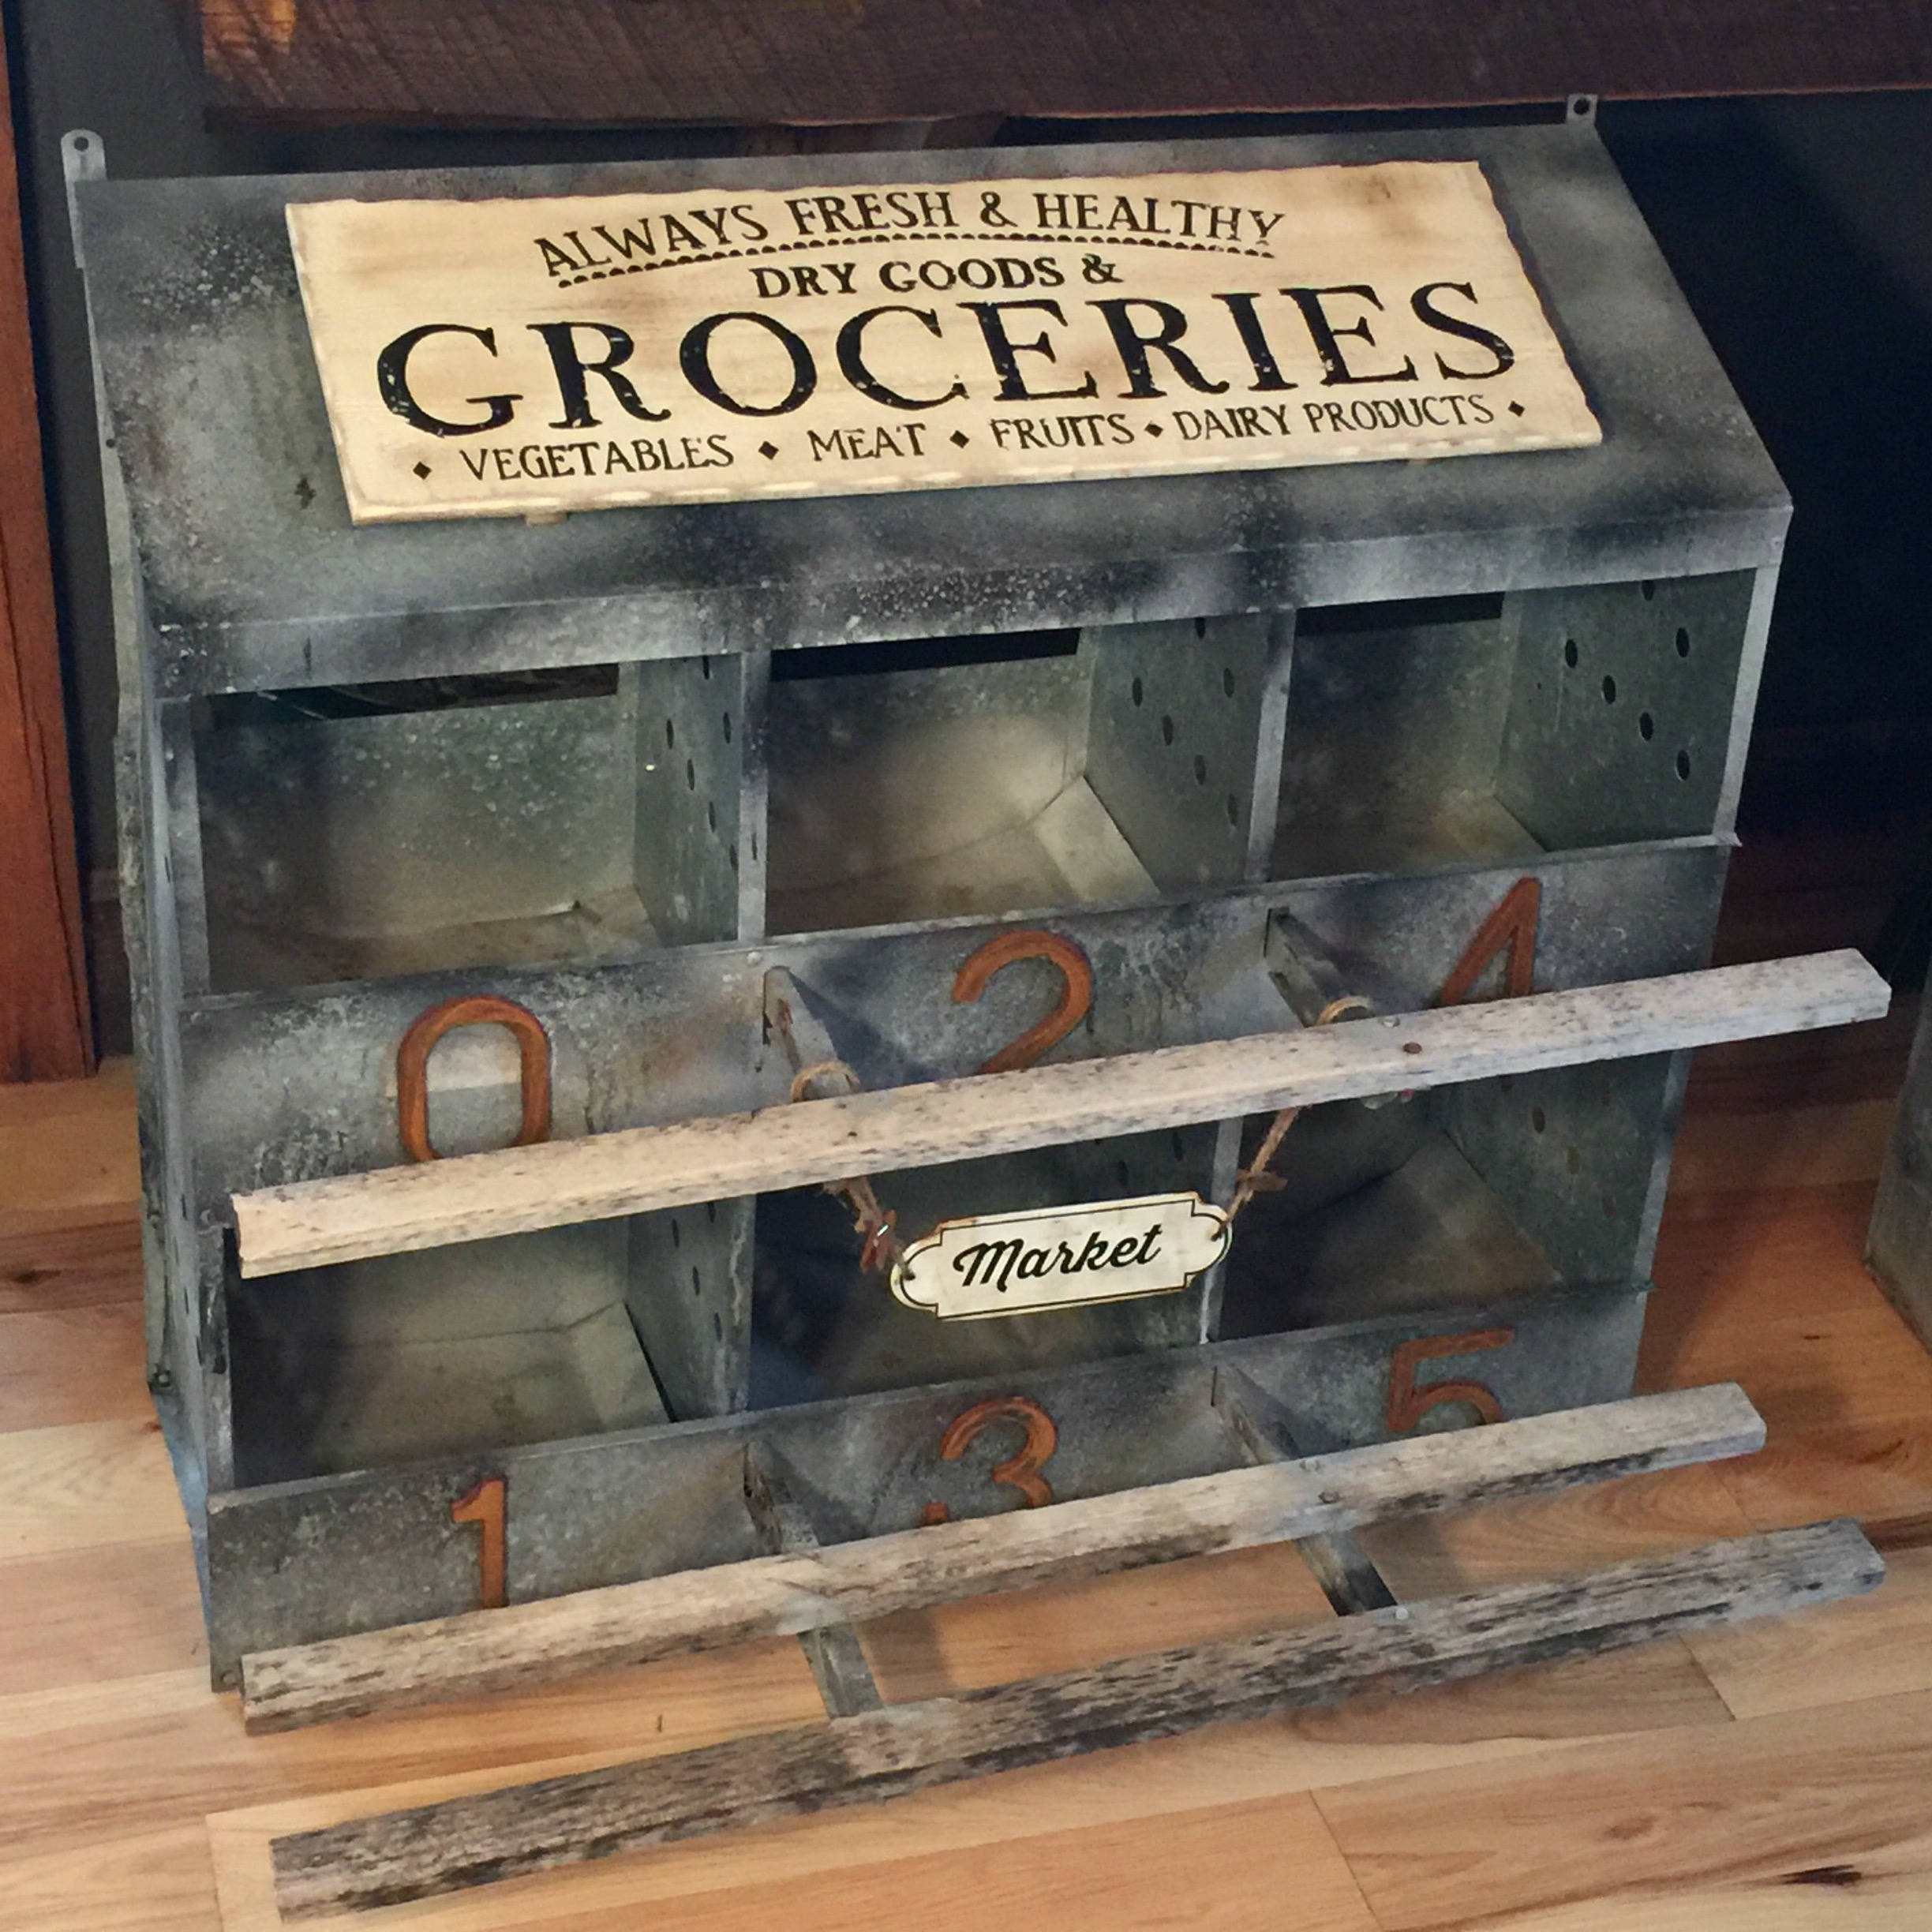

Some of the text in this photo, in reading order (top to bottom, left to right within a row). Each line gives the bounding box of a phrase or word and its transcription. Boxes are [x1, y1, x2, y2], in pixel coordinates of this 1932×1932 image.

[534, 190, 1286, 278] ALWAYS FRESH & HEALTHY
[750, 254, 1125, 299] DRY GOODS &
[376, 282, 1515, 437] GROCERIES
[459, 394, 1496, 481] VEGETABLES MEAT FRUITS DAIRY PRODUCTS
[951, 930, 1091, 1074] 2
[397, 993, 551, 1160] 0
[953, 1223, 1163, 1294] Market
[1387, 1325, 1515, 1431] 5
[922, 1395, 1058, 1527] 3
[451, 1477, 510, 1608] 1
